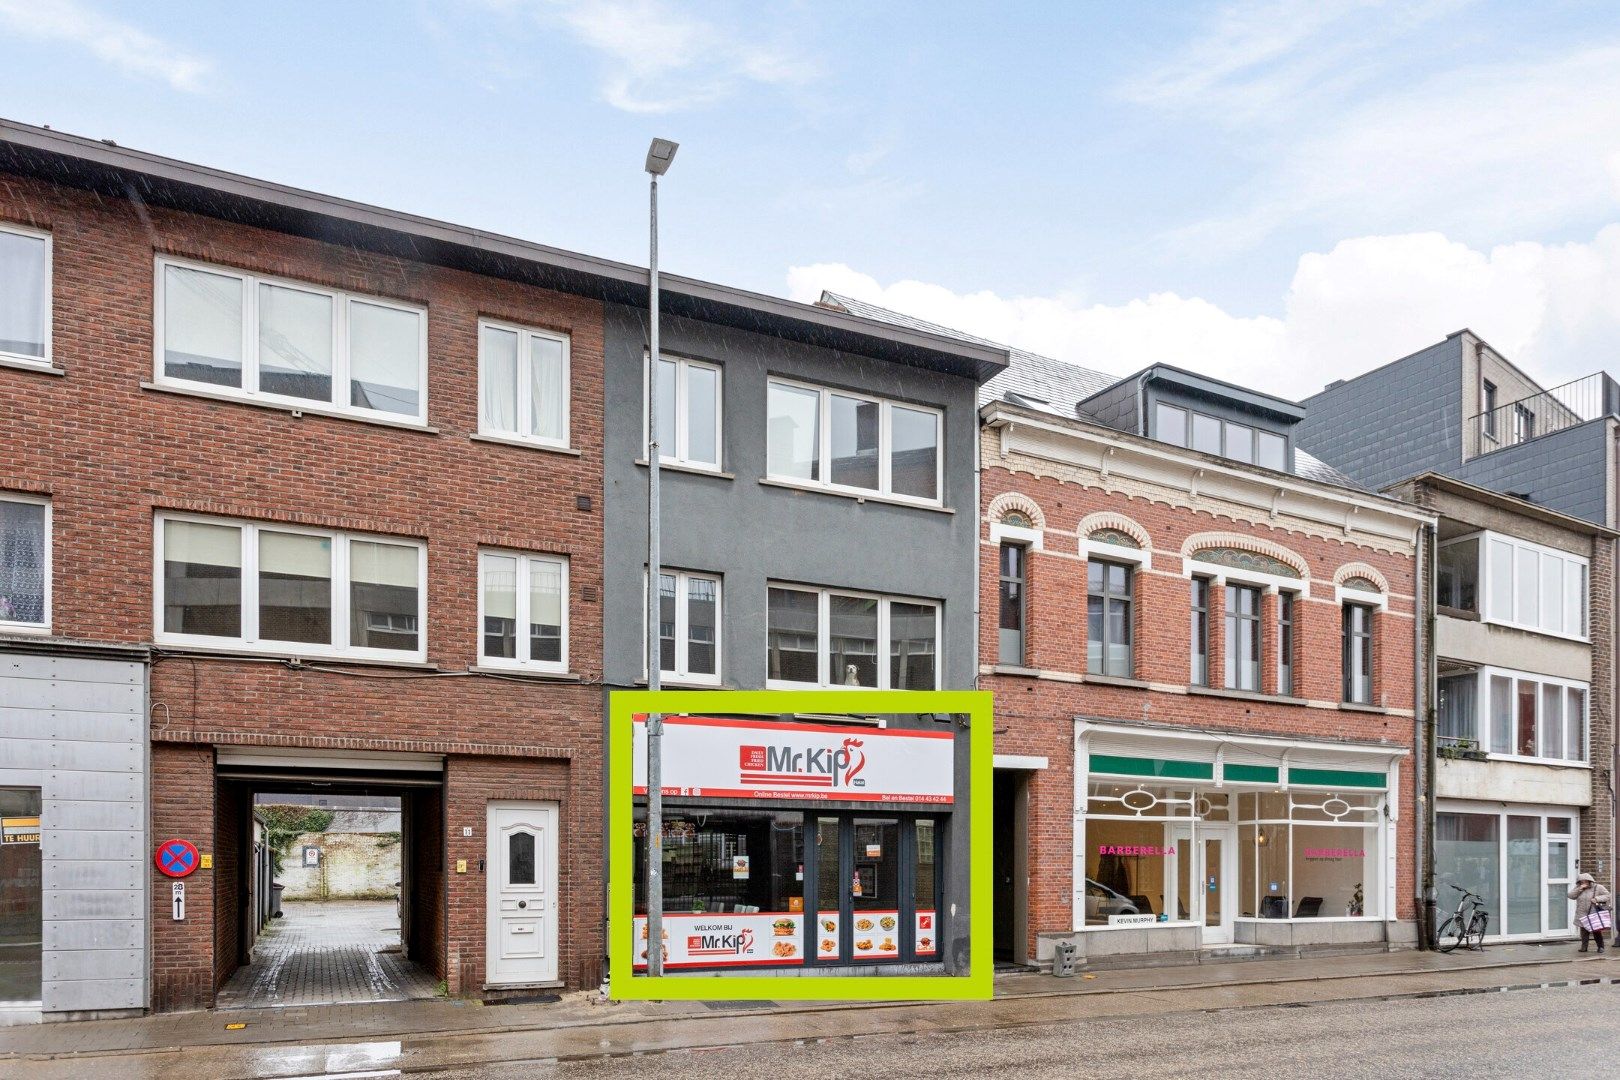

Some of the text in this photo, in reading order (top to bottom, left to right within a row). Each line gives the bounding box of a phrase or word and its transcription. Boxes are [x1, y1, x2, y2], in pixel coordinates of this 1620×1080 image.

[4, 834, 40, 842] TE HUUR
[1099, 845, 1176, 855] BARBERELLA
